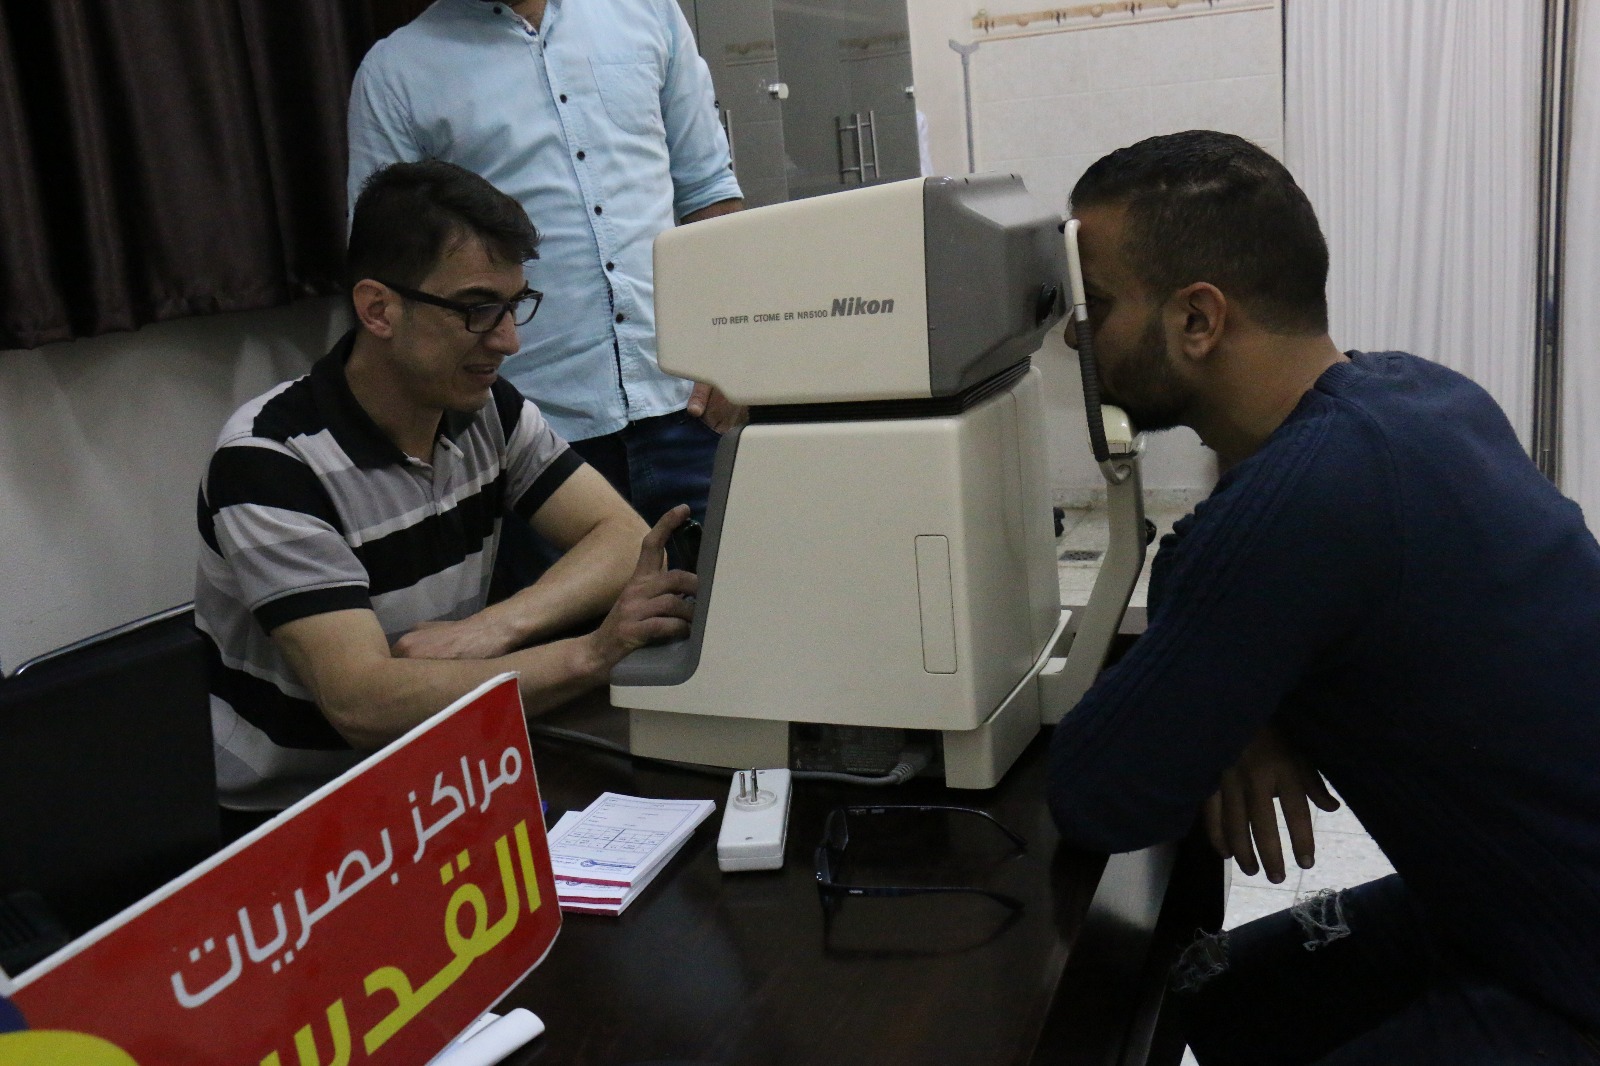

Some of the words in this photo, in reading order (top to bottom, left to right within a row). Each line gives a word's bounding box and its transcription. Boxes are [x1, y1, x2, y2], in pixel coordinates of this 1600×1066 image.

[797, 309, 828, 319] NR5100
[830, 296, 895, 317] Nikon
[408, 745, 523, 864] مراكز
[170, 827, 399, 1009] بصريات
